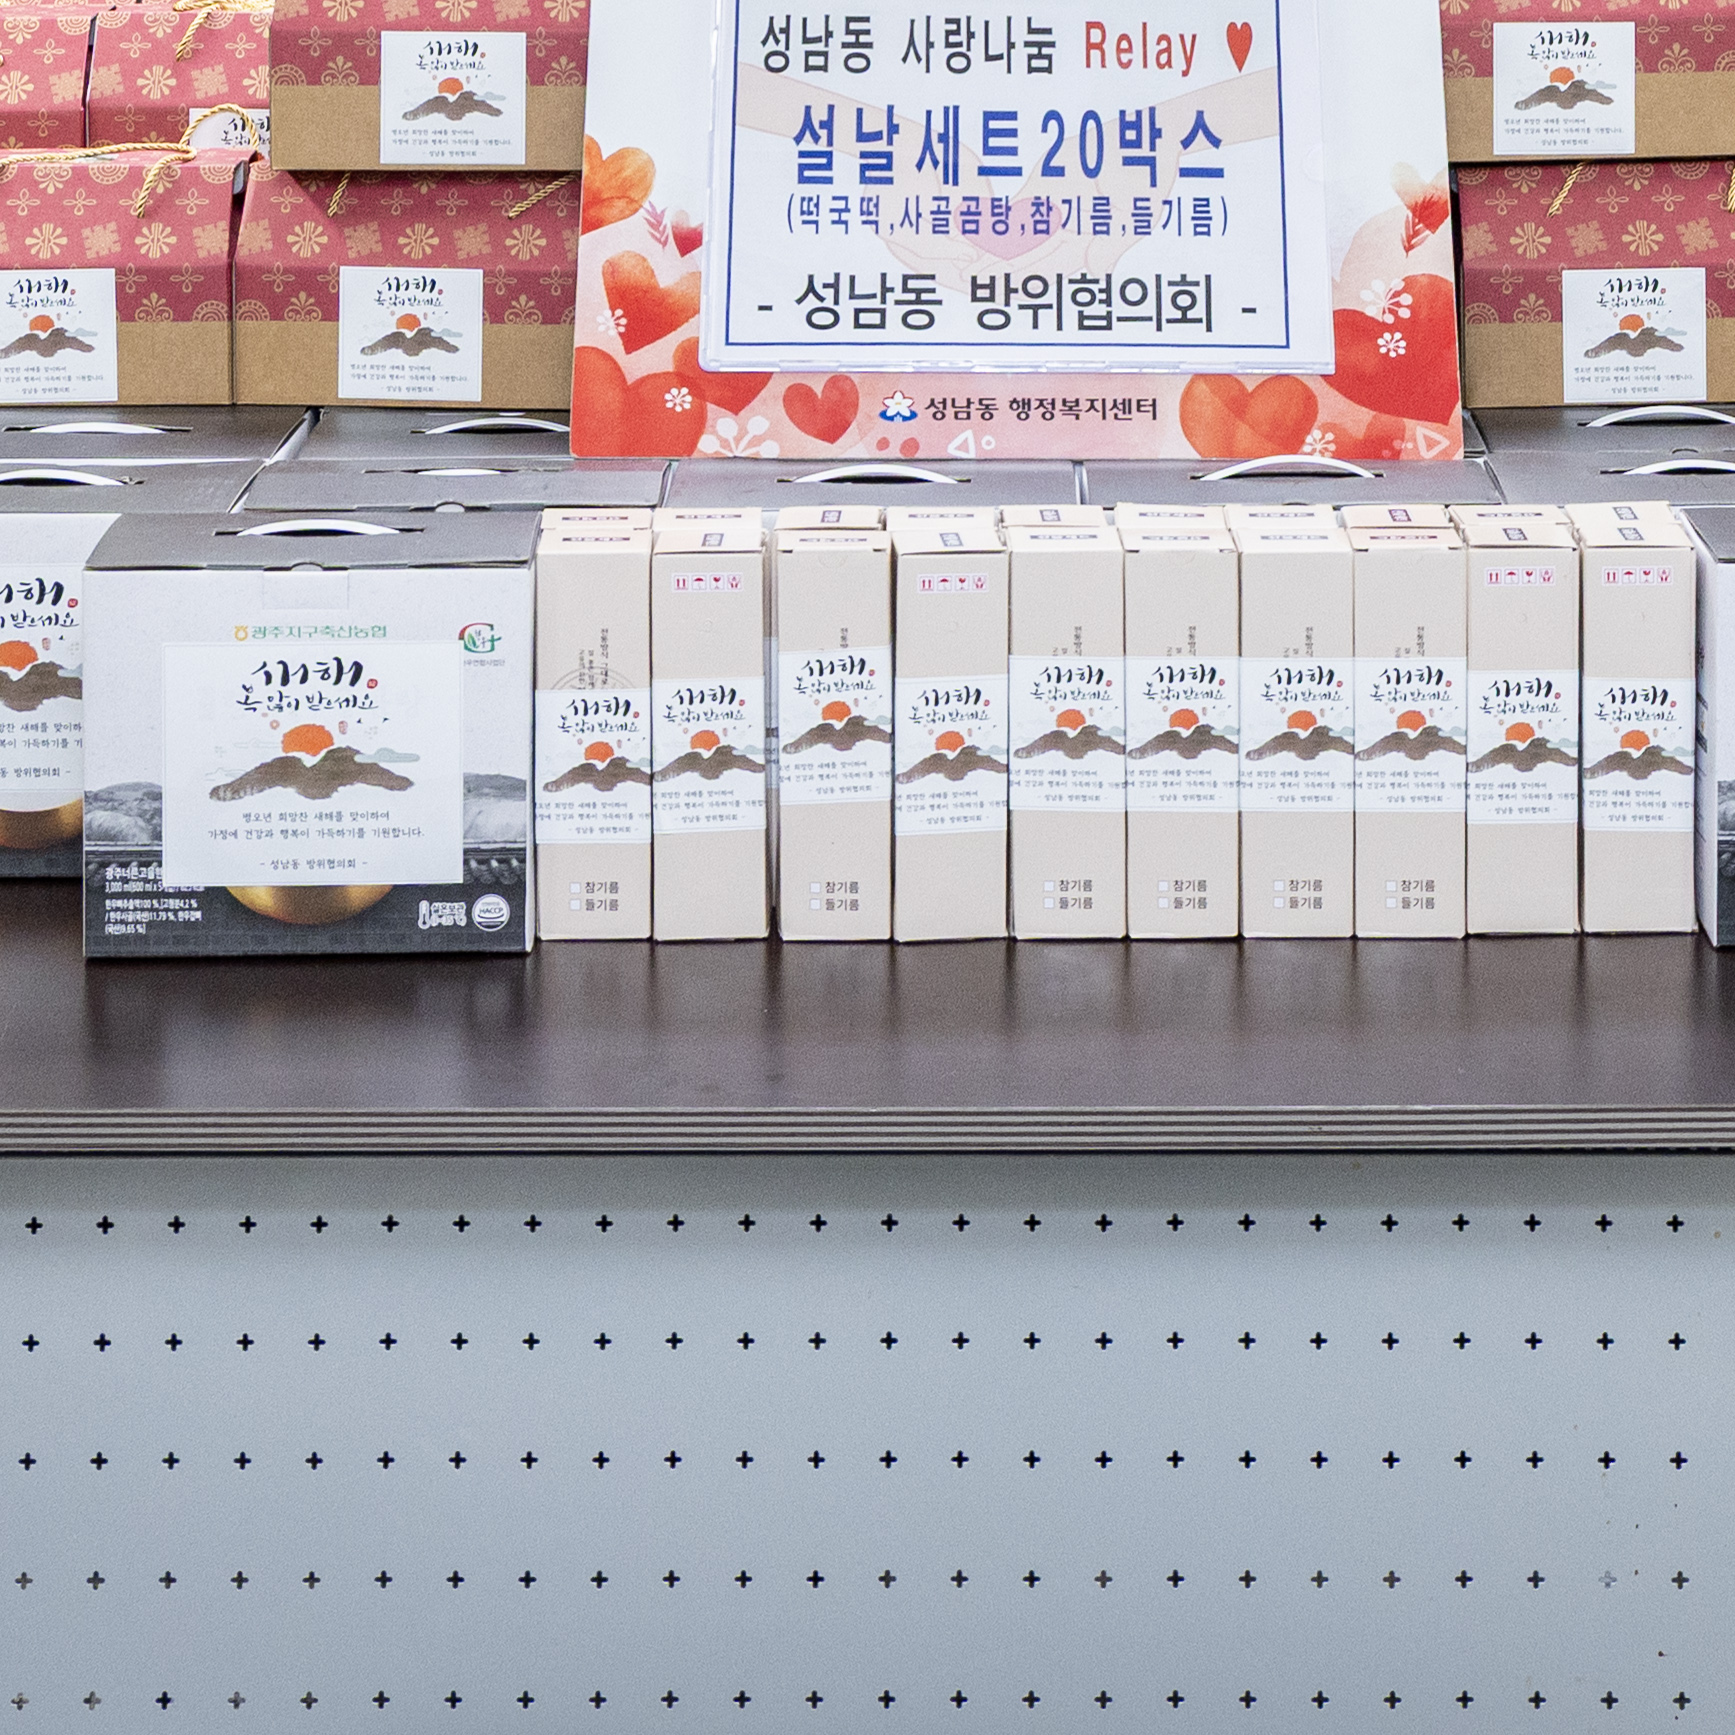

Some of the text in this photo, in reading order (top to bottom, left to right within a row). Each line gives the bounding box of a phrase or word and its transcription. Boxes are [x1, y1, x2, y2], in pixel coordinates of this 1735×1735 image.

[760, 13, 1198, 77] 성남동 사랑나눔 Relay
[795, 272, 944, 332] 성남동
[968, 273, 1216, 334] 방위협의회
[923, 396, 1159, 423] 성남동 행정복지센터
[251, 624, 387, 639] 광주지구축산농협
[252, 656, 363, 687] 새해
[21, 722, 49, 732] 새해를
[54, 722, 82, 733] 맞이하
[22, 739, 69, 749] 가득하기를
[14, 767, 61, 777] 방위협의회
[242, 811, 390, 822] 병오년 희망찬 새해를 맞이하여
[208, 828, 238, 839] 가정에
[244, 828, 274, 839] 건강과
[280, 828, 310, 839] 행복이
[315, 828, 365, 839] 가득하기를
[270, 858, 356, 870] 성남동 방위협의회
[585, 882, 619, 894] 참기름
[825, 881, 860, 893] 참기름
[1059, 880, 1093, 892] 참기름
[1173, 879, 1208, 892] 참기름
[1289, 879, 1323, 892] 참기름
[1401, 879, 1436, 892] 참기름
[585, 899, 619, 911] 들기름
[825, 898, 860, 910] 들기름
[1059, 897, 1093, 909] 들기름
[1173, 896, 1208, 909] 들기름
[1289, 896, 1323, 909] 들기름
[1401, 896, 1436, 909] 들기름
